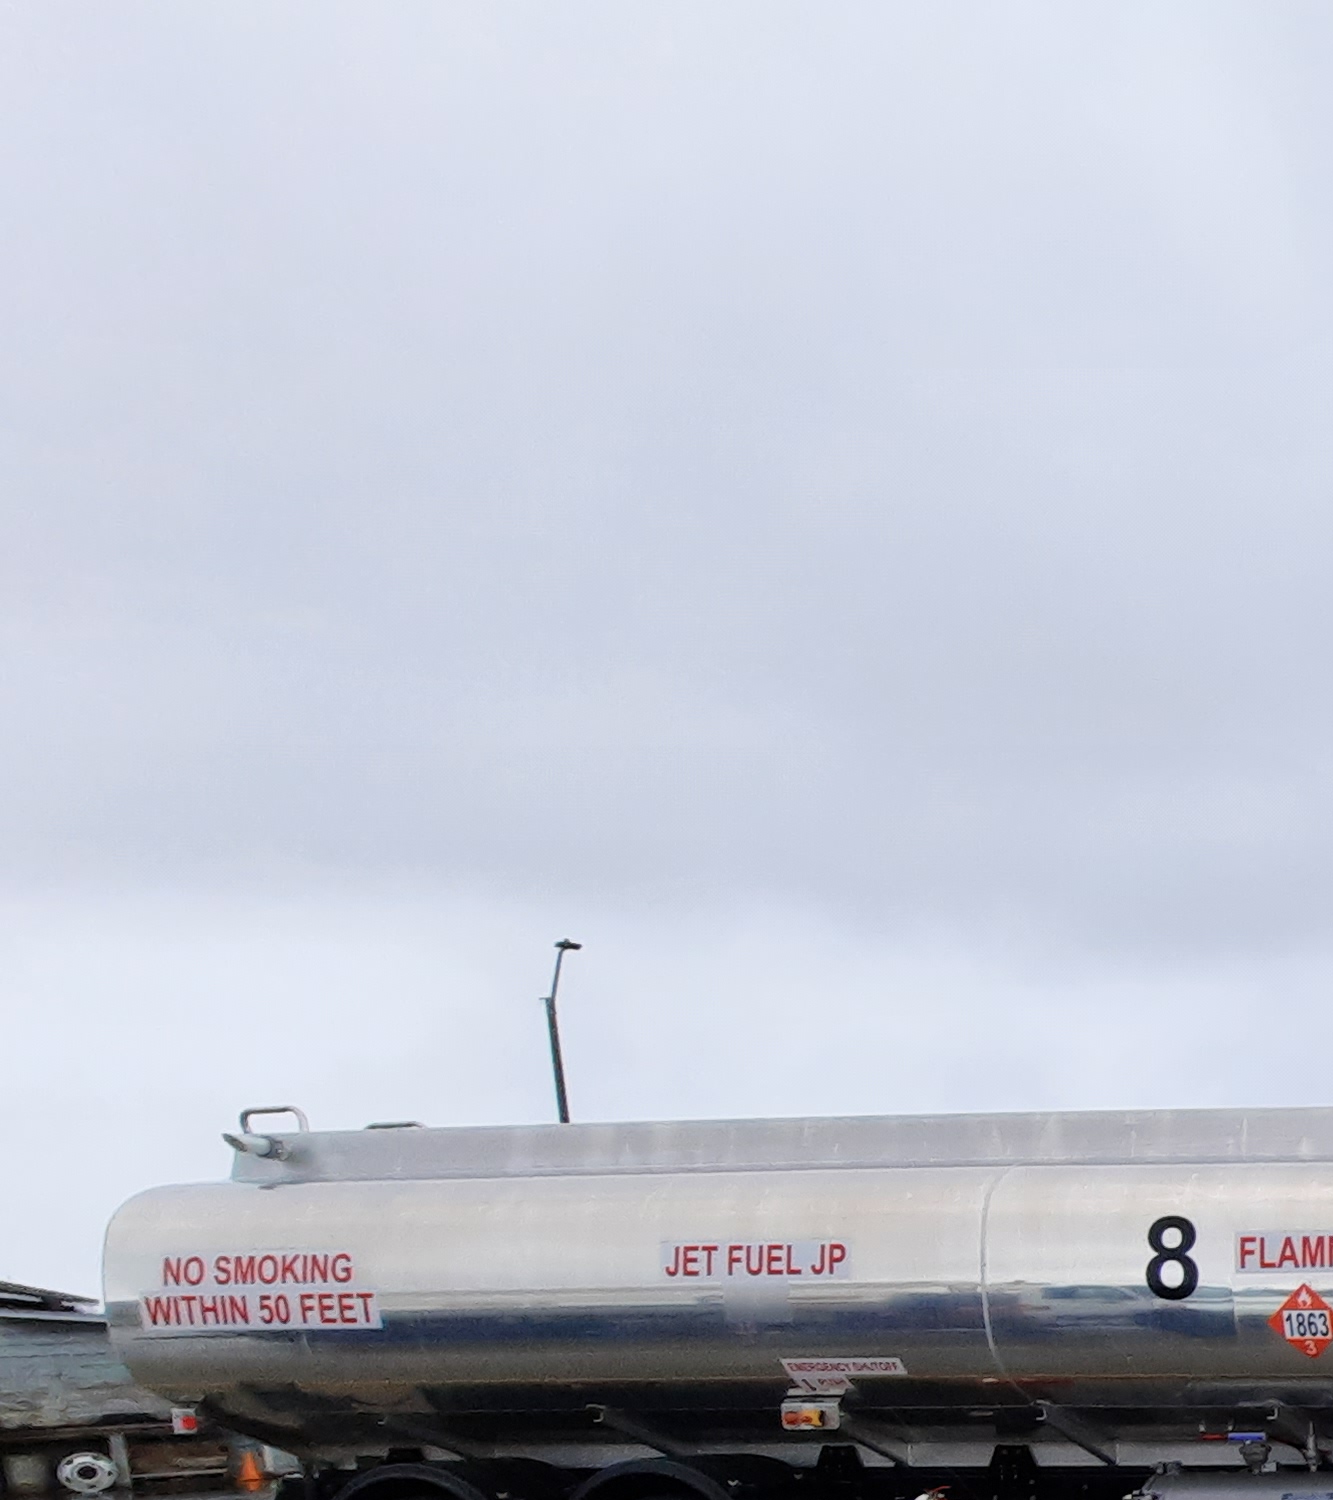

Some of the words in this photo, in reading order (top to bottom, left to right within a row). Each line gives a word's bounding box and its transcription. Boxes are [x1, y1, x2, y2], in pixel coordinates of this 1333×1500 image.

[163, 1256, 204, 1286] NO
[213, 1253, 353, 1285] SMOKING
[665, 1246, 719, 1276] JET
[728, 1245, 802, 1275] FUEL
[811, 1243, 846, 1275] JP
[1146, 1215, 1199, 1300] 8
[145, 1295, 249, 1325] WITHIN
[259, 1294, 290, 1324] 50
[300, 1292, 374, 1324] FEET
[1285, 1312, 1330, 1337] 1863
[1304, 1340, 1318, 1355] 3
